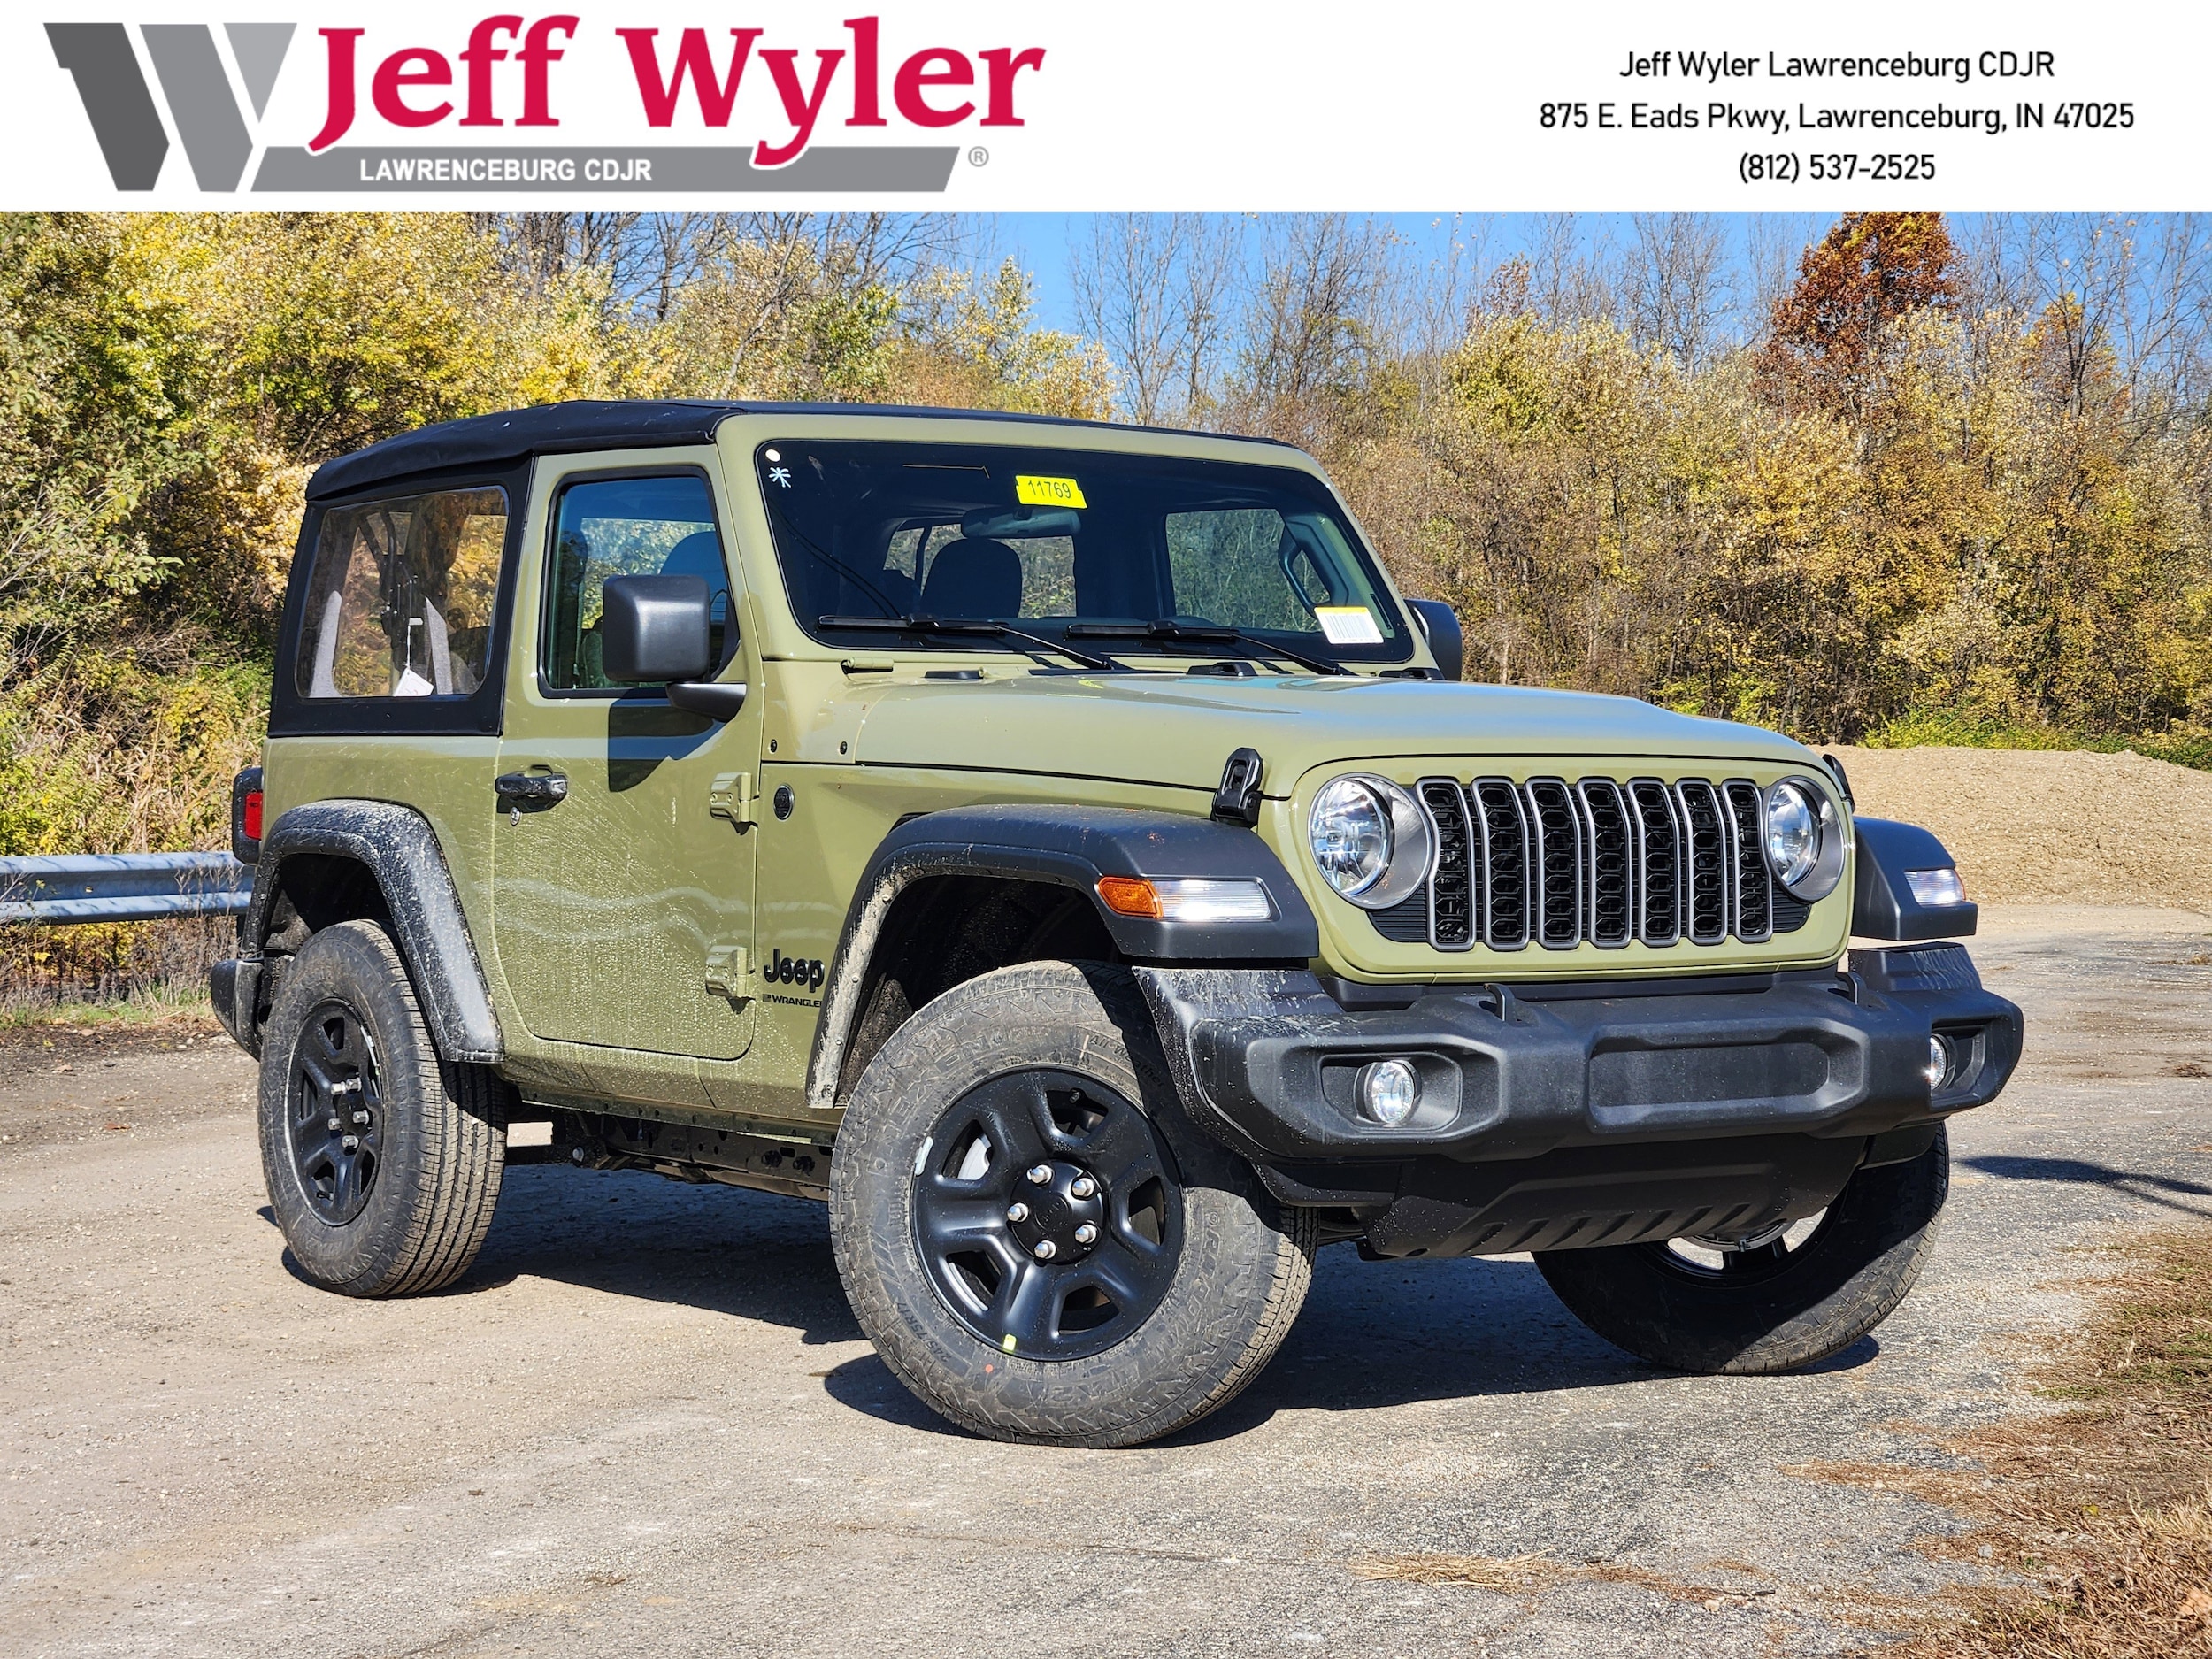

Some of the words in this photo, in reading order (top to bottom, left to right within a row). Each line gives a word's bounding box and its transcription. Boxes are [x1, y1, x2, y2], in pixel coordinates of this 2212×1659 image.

[1028, 480, 1071, 499] 11769
[764, 948, 826, 994] Jeep
[896, 1302, 953, 1363] 245/75R17
